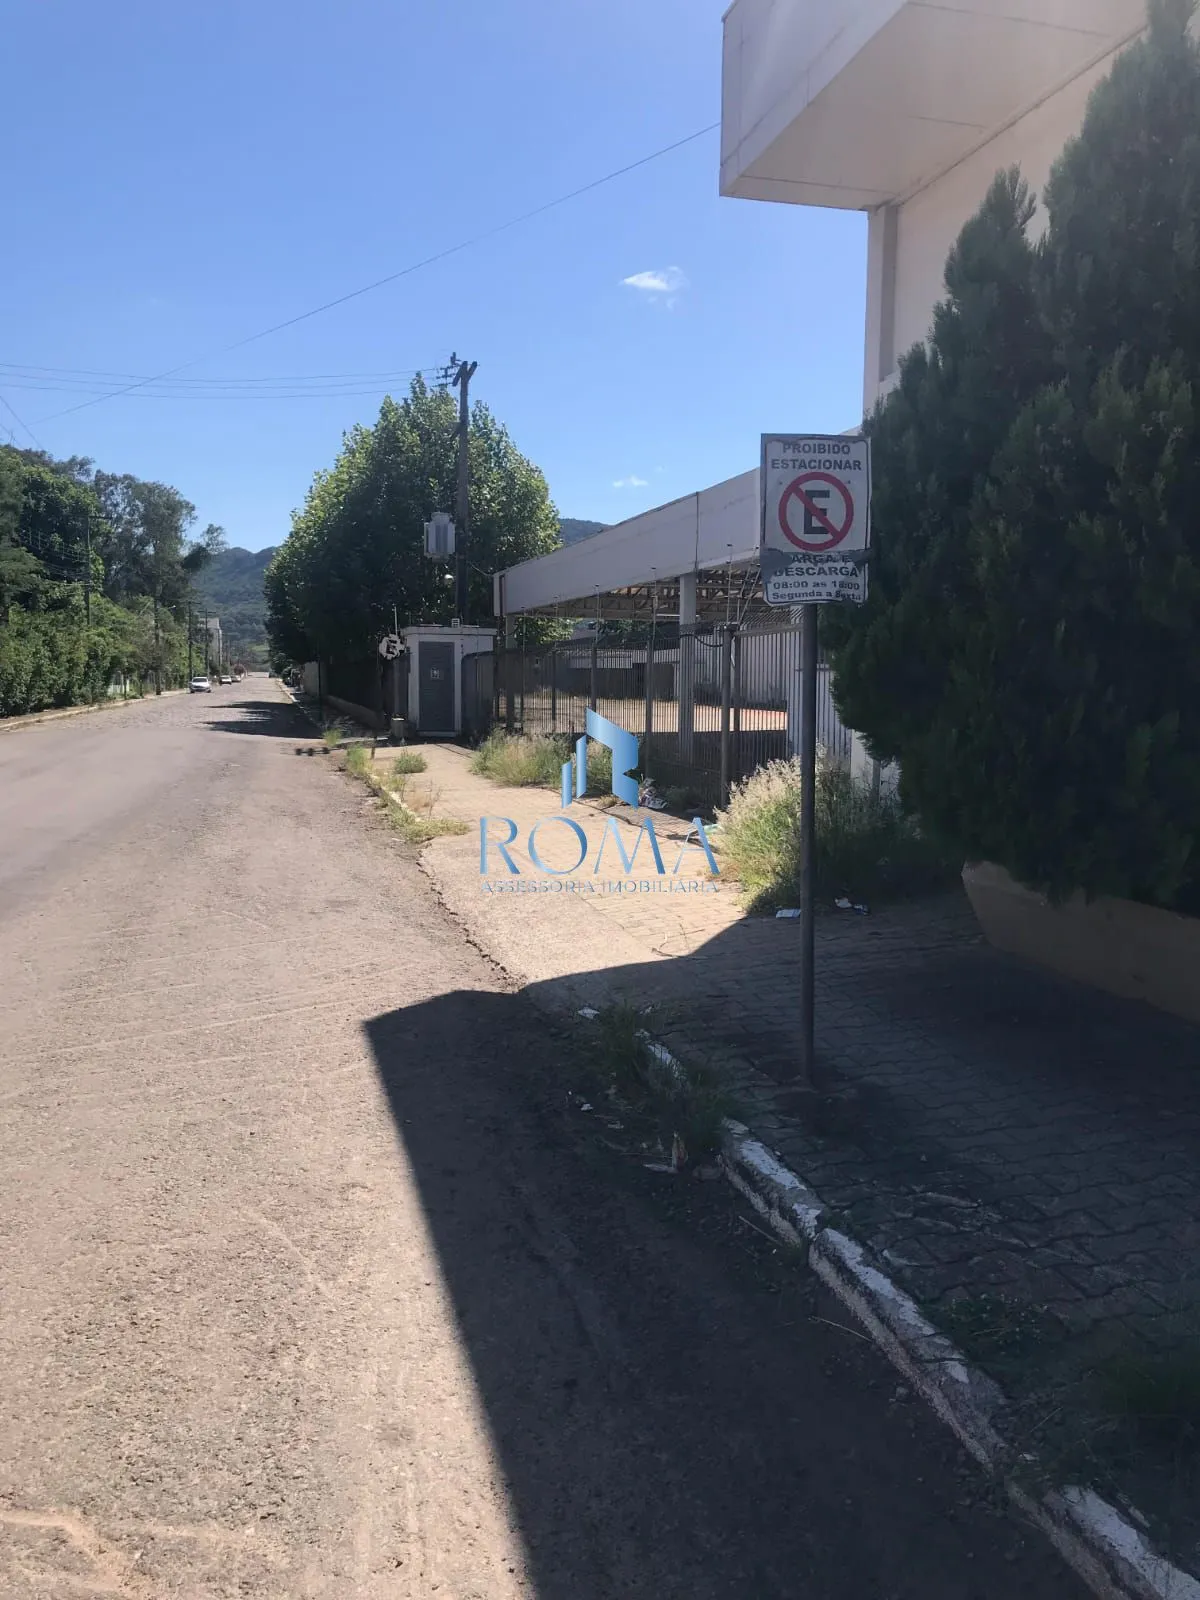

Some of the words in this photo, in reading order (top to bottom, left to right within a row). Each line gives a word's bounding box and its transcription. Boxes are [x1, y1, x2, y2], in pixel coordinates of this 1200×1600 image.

[783, 444, 850, 455] PROIBIDO
[771, 459, 862, 471] ESTACIONAR
[803, 490, 830, 534] E
[772, 590, 821, 601] Segunda
